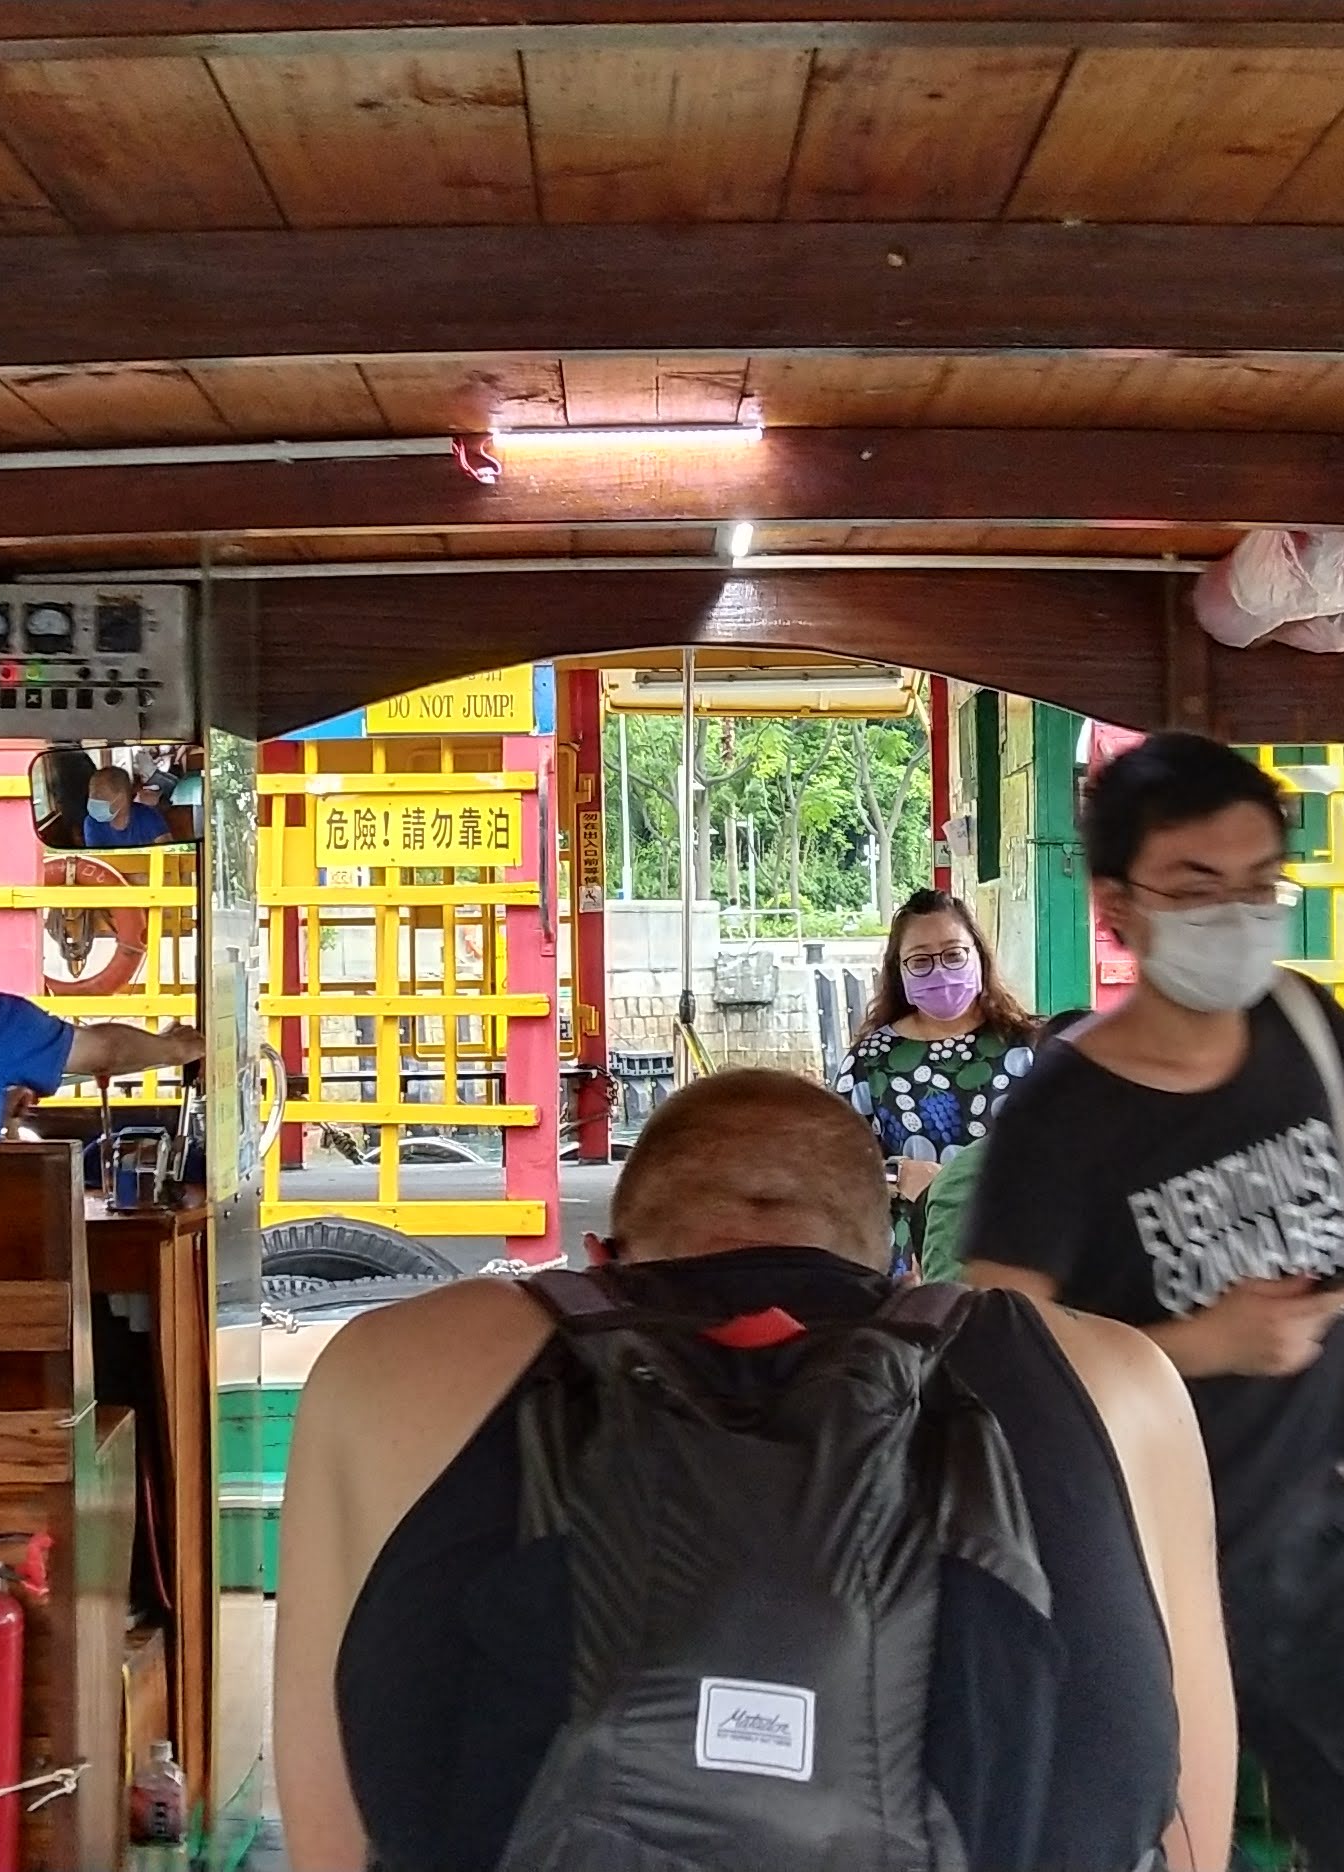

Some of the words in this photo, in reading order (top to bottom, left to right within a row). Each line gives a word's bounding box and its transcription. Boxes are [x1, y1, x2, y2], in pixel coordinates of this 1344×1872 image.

[388, 694, 410, 718] DO
[419, 694, 454, 718] NOT
[462, 694, 514, 718] JUMP!
